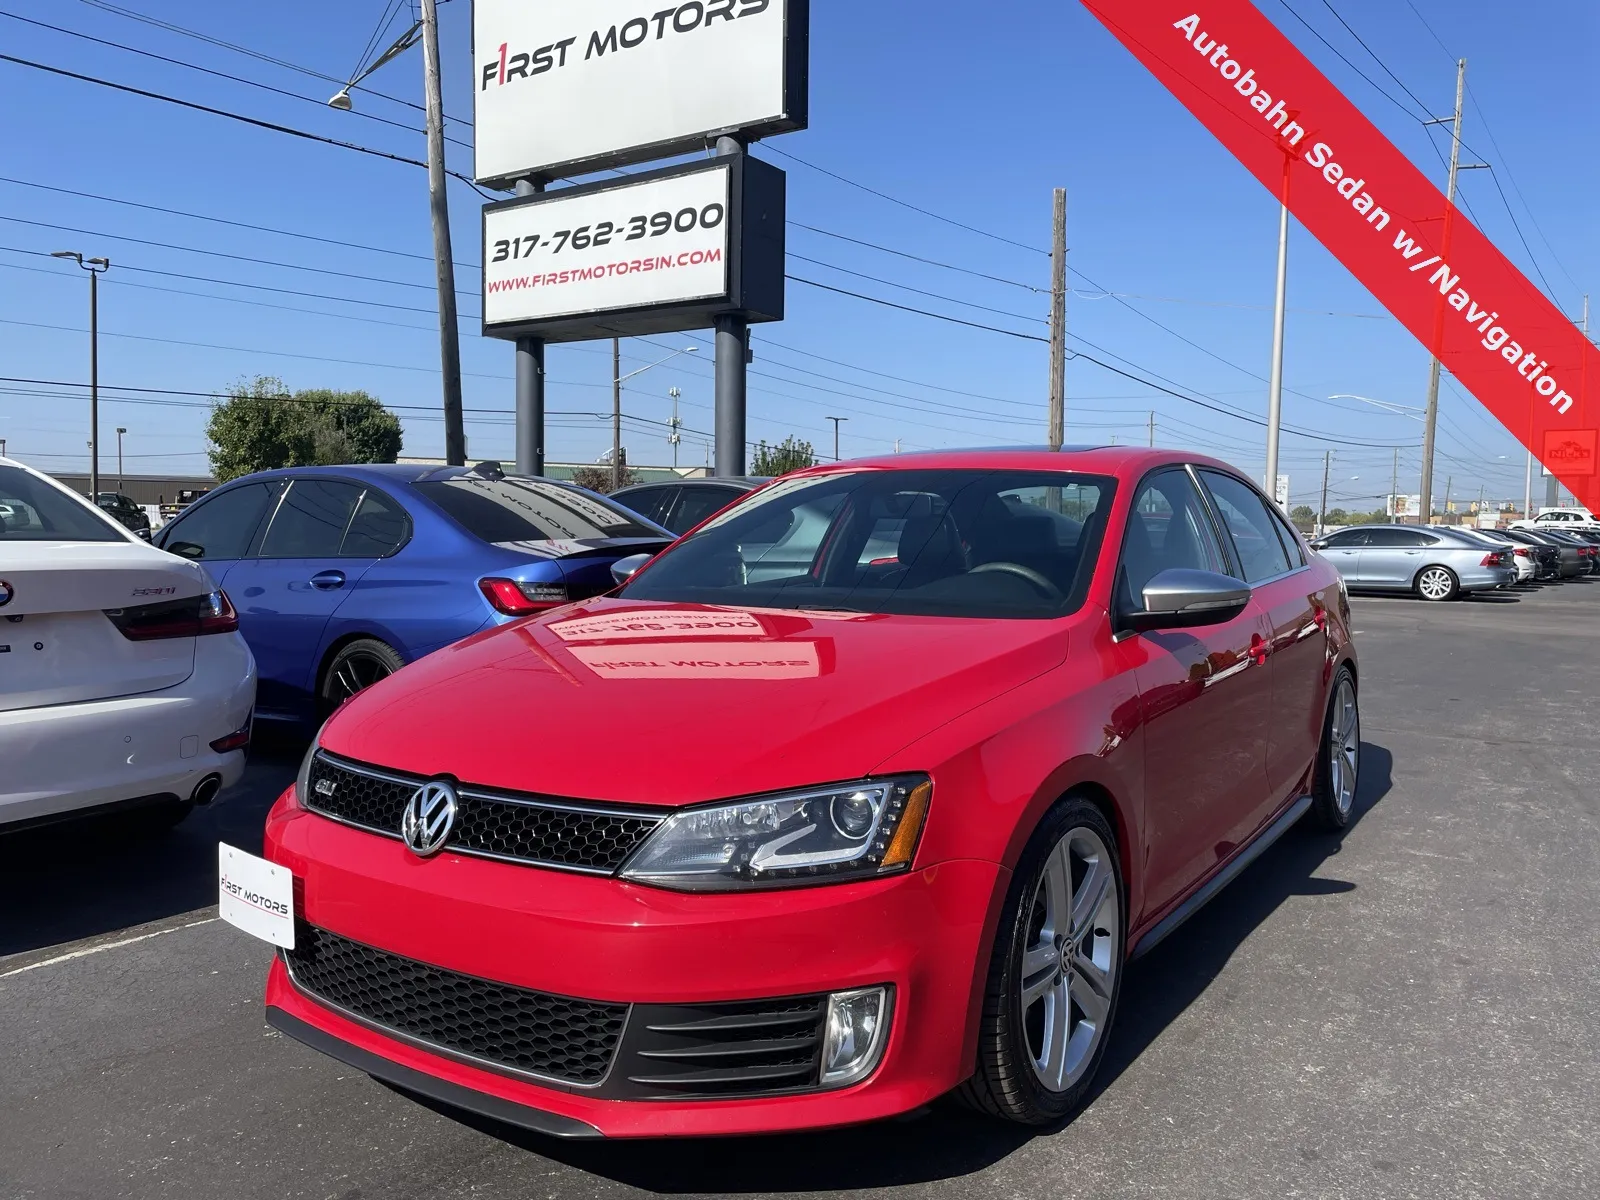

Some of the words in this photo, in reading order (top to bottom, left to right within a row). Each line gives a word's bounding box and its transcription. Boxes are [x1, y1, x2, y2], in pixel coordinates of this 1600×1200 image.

[584, 0, 769, 60] MOTORS
[492, 203, 724, 263] 317-762-3900
[488, 248, 721, 293] WWW.FIRSTMOTORSIN.COM
[244, 889, 288, 915] MOTORS
